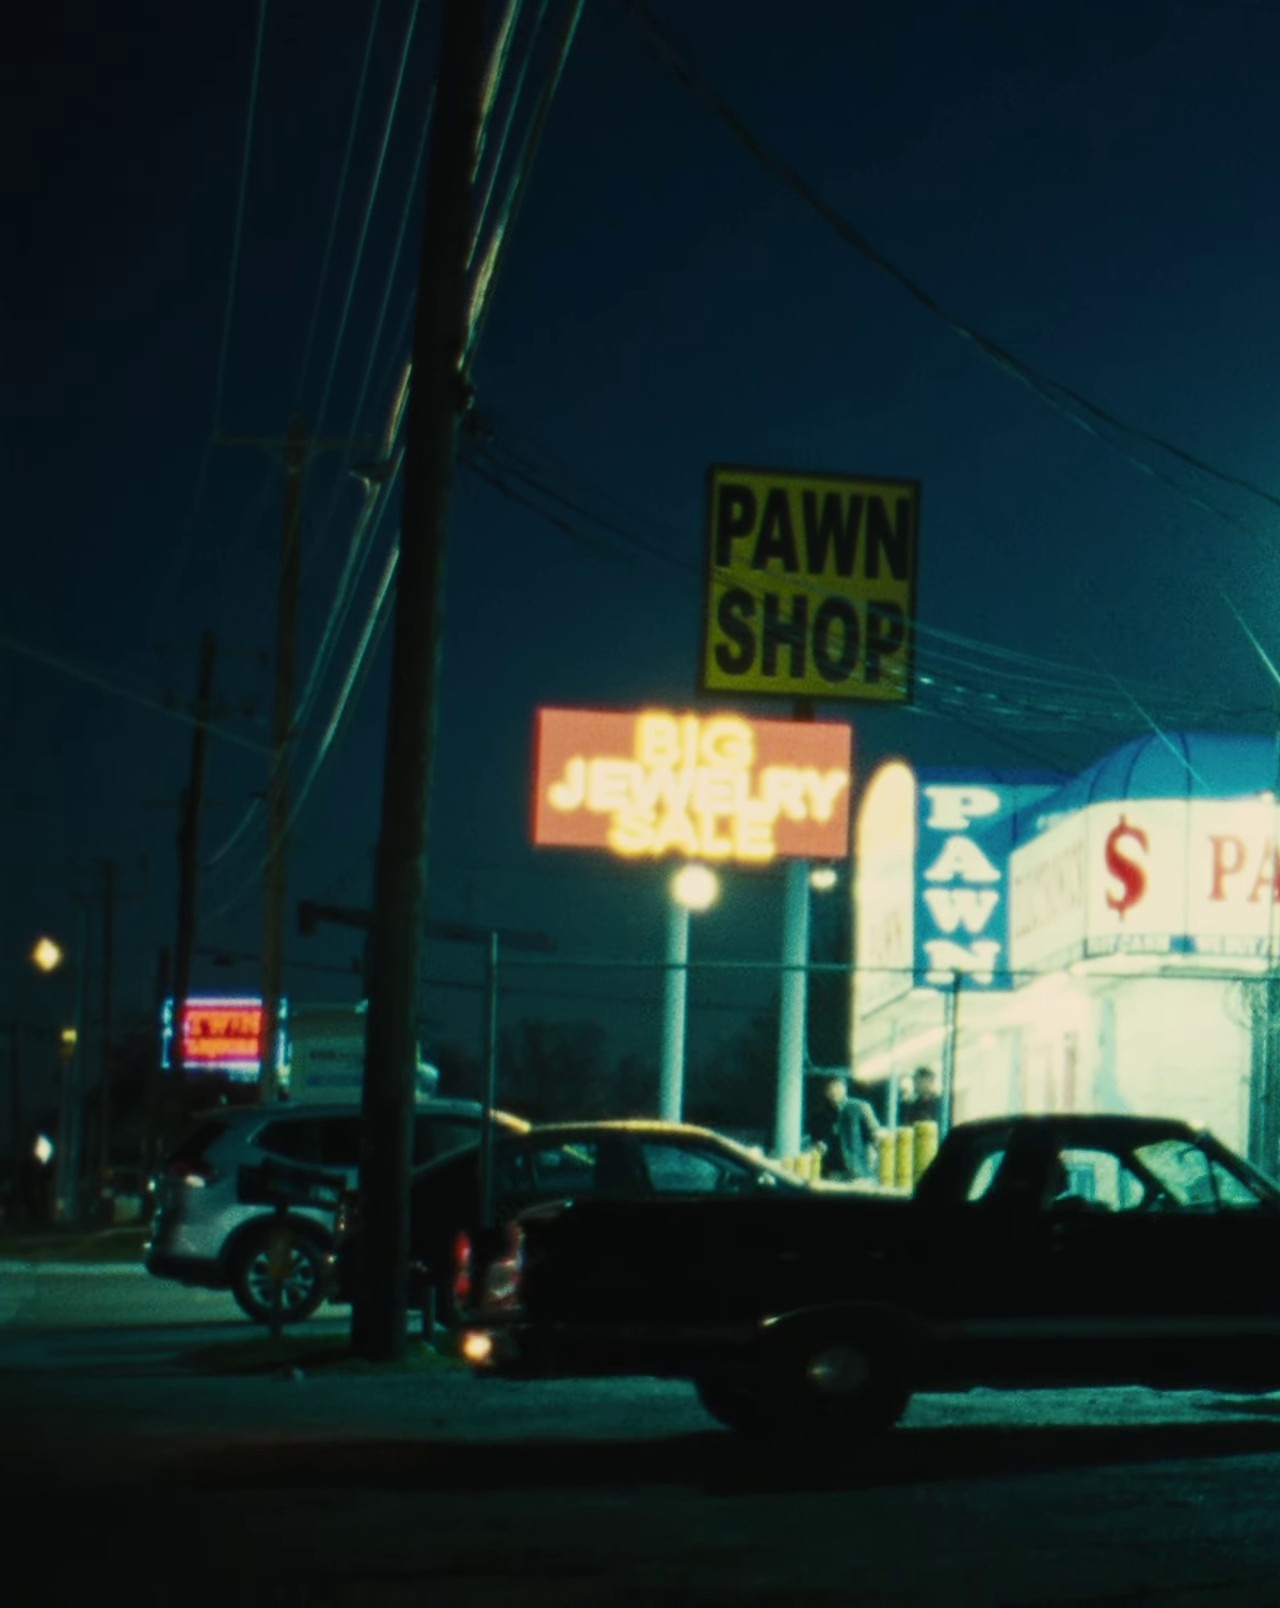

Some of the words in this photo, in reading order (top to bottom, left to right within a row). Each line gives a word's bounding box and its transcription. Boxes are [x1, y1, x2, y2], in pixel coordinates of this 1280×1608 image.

[714, 482, 909, 581] PAWN
[713, 586, 905, 684] SHOP
[637, 711, 755, 769] BIG
[547, 756, 849, 822] JEWELRY
[612, 800, 777, 860] SALE
[923, 785, 1001, 985] PAWN
